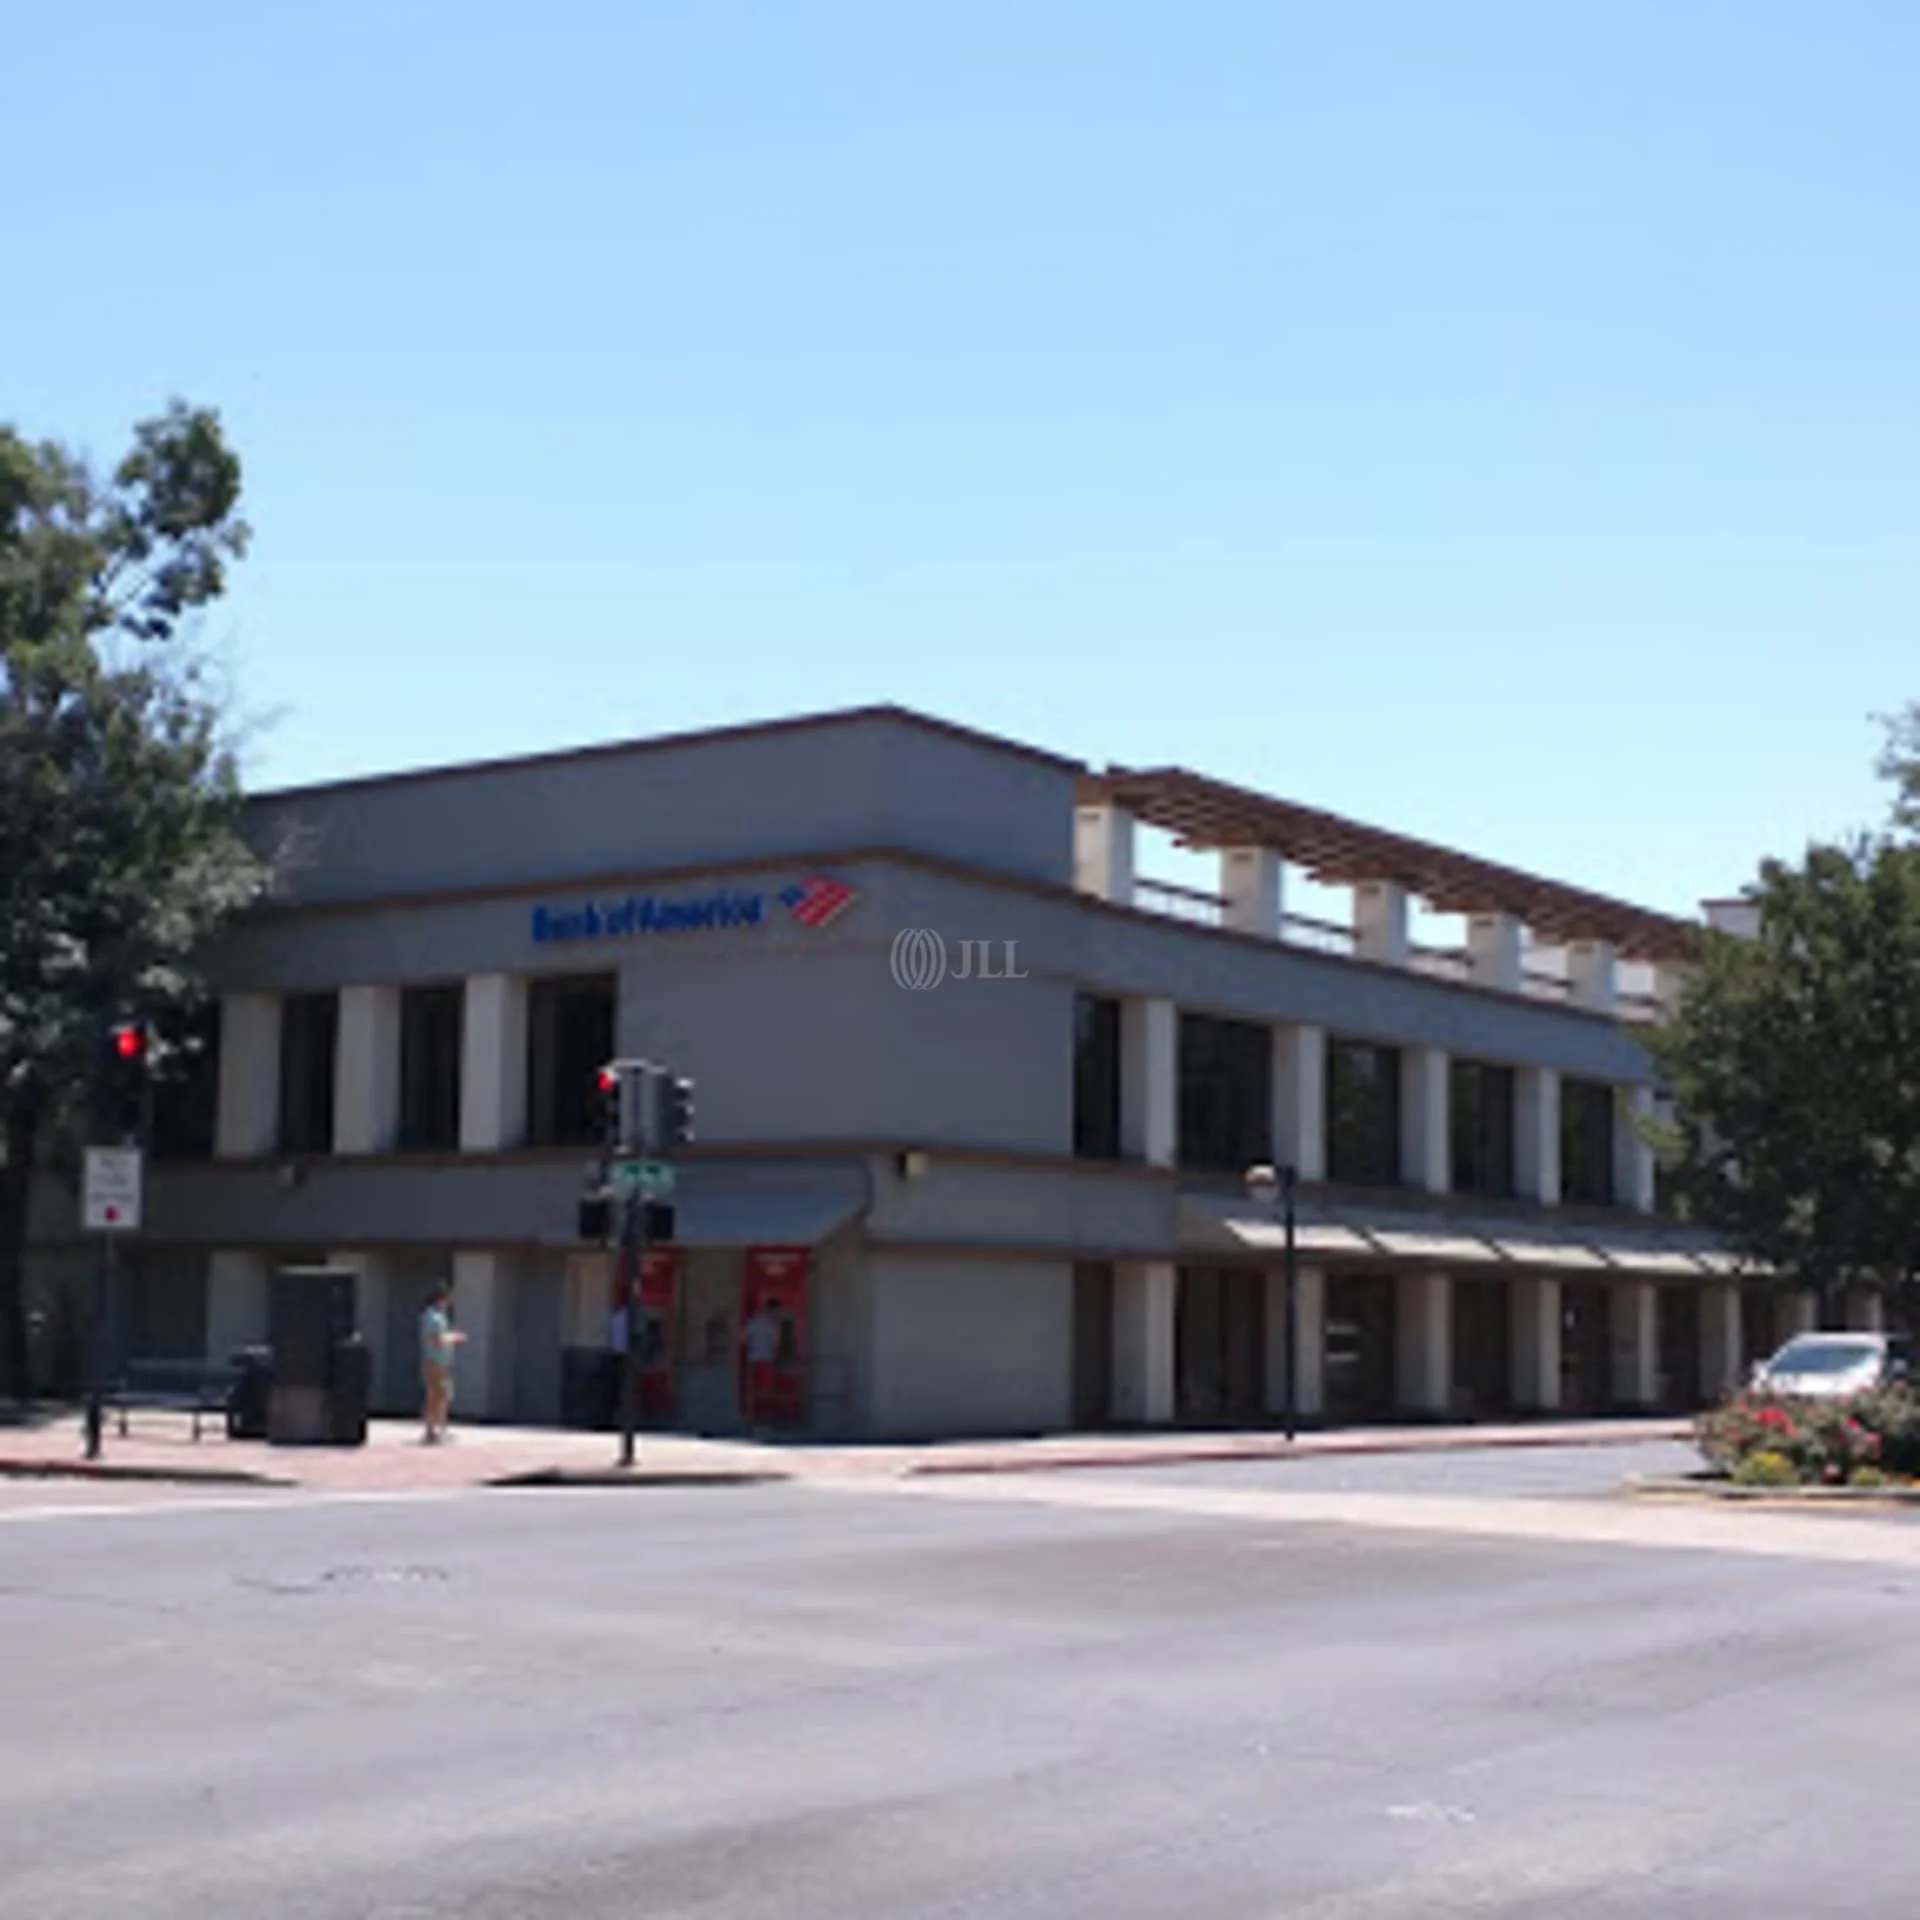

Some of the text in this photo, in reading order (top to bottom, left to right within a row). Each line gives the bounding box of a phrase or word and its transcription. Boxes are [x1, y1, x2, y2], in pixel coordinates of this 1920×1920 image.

[532, 890, 764, 942] Bank of America
